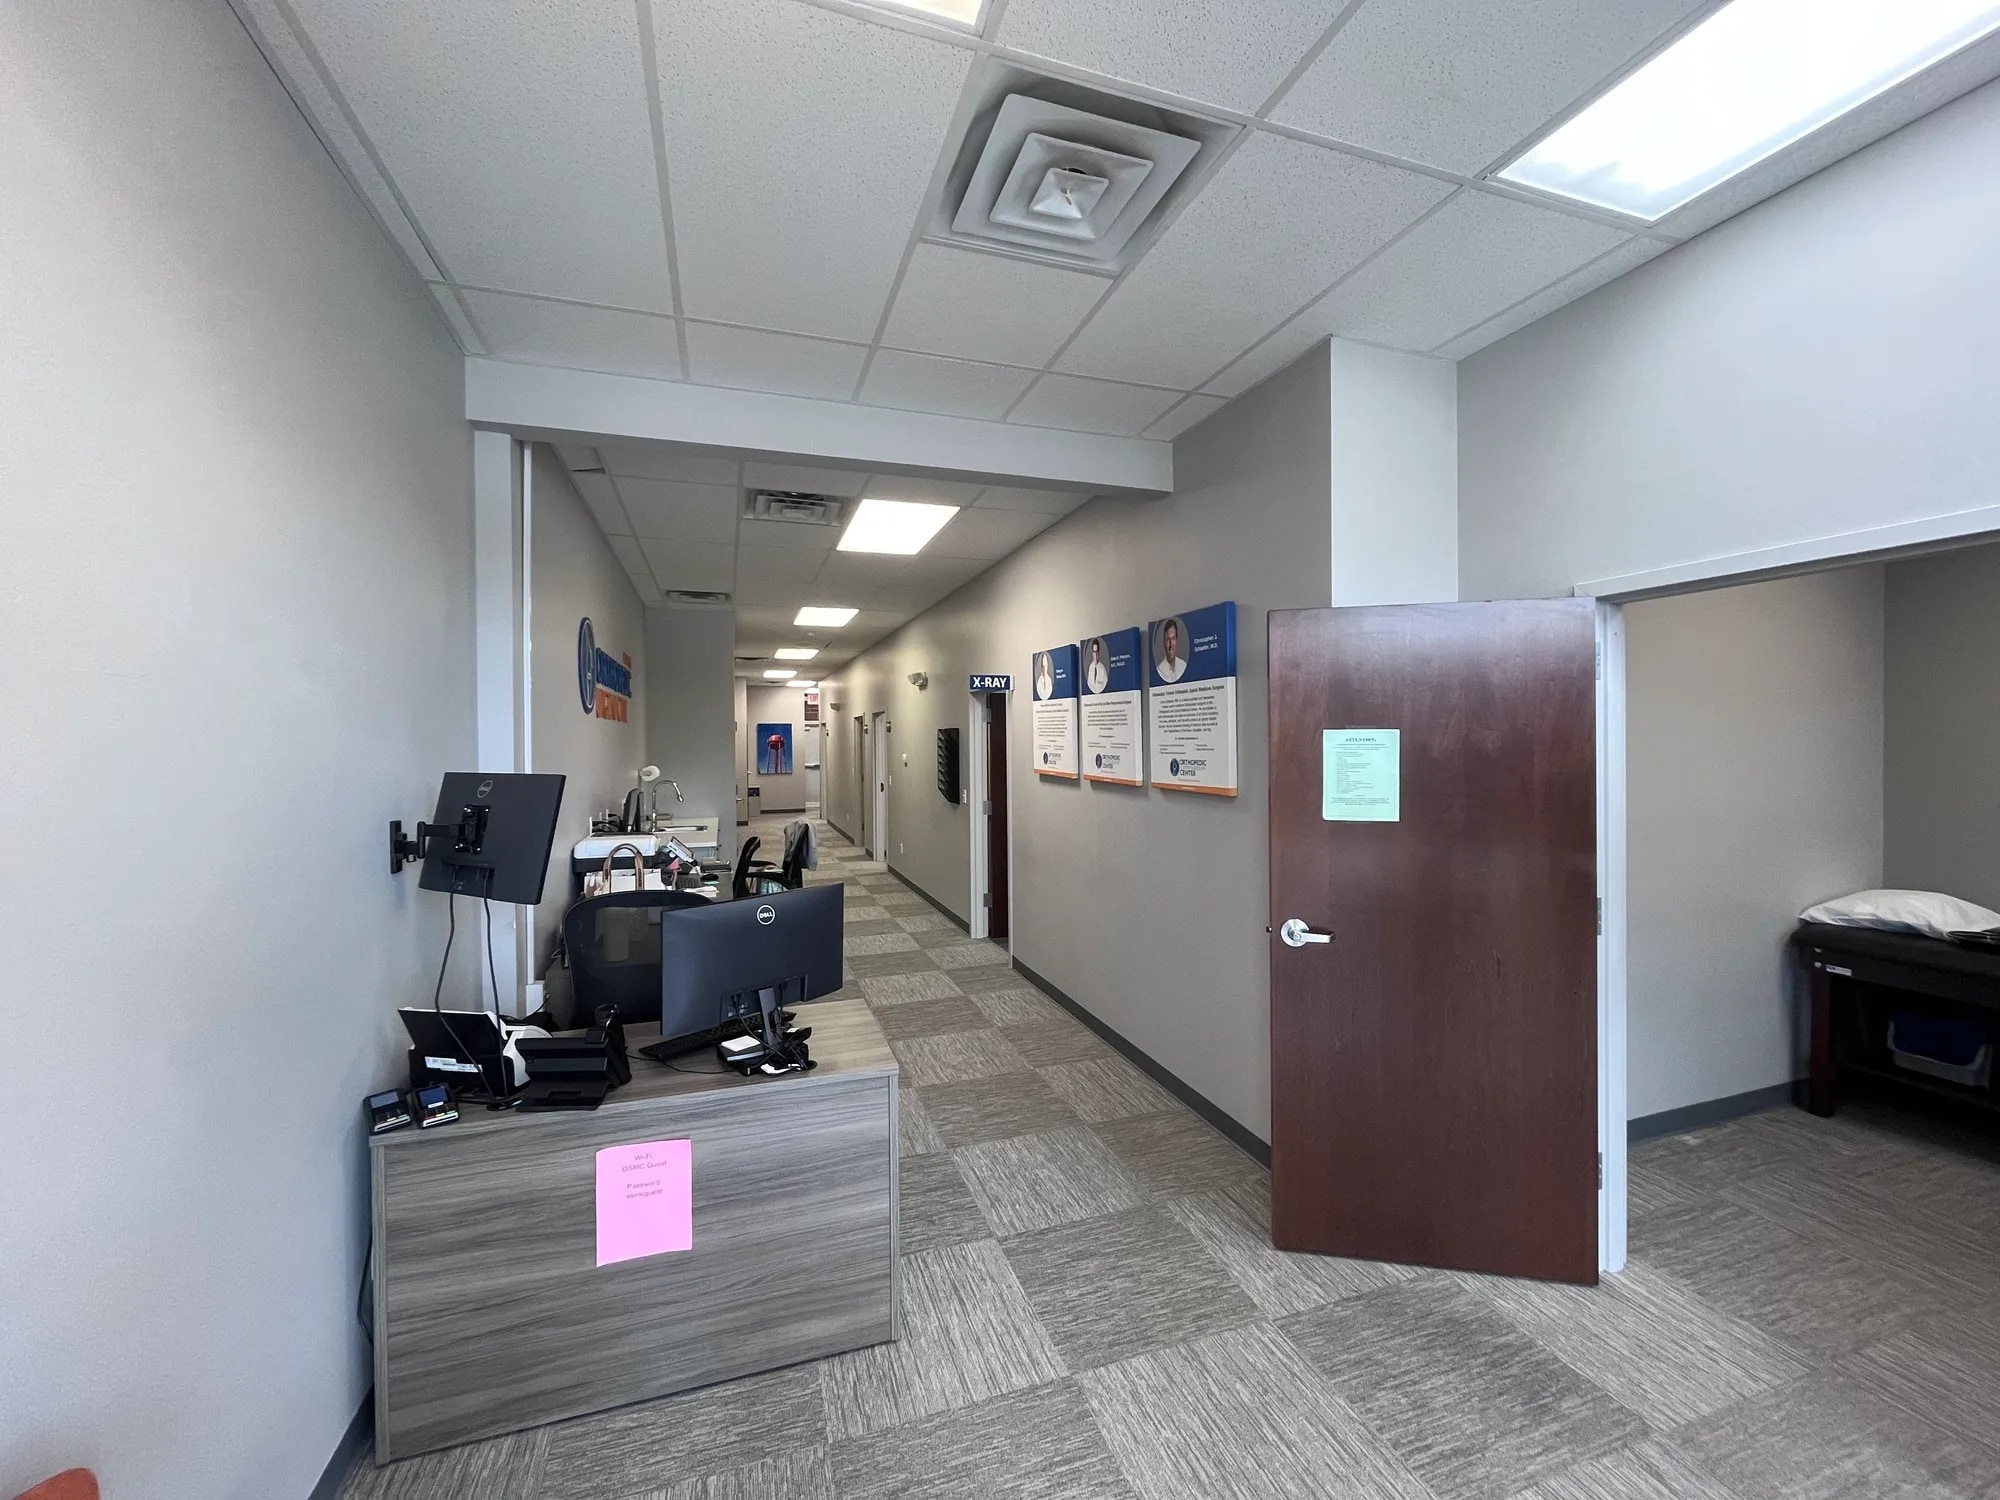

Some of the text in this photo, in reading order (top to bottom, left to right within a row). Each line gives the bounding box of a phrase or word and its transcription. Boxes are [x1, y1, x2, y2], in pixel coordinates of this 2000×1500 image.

[973, 676, 1007, 688] X-RAY
[759, 911, 773, 919] DELL
[634, 1153, 653, 1161] Wi-Fi
[622, 1160, 667, 1172] OSMC Guest
[626, 1180, 660, 1189] Password
